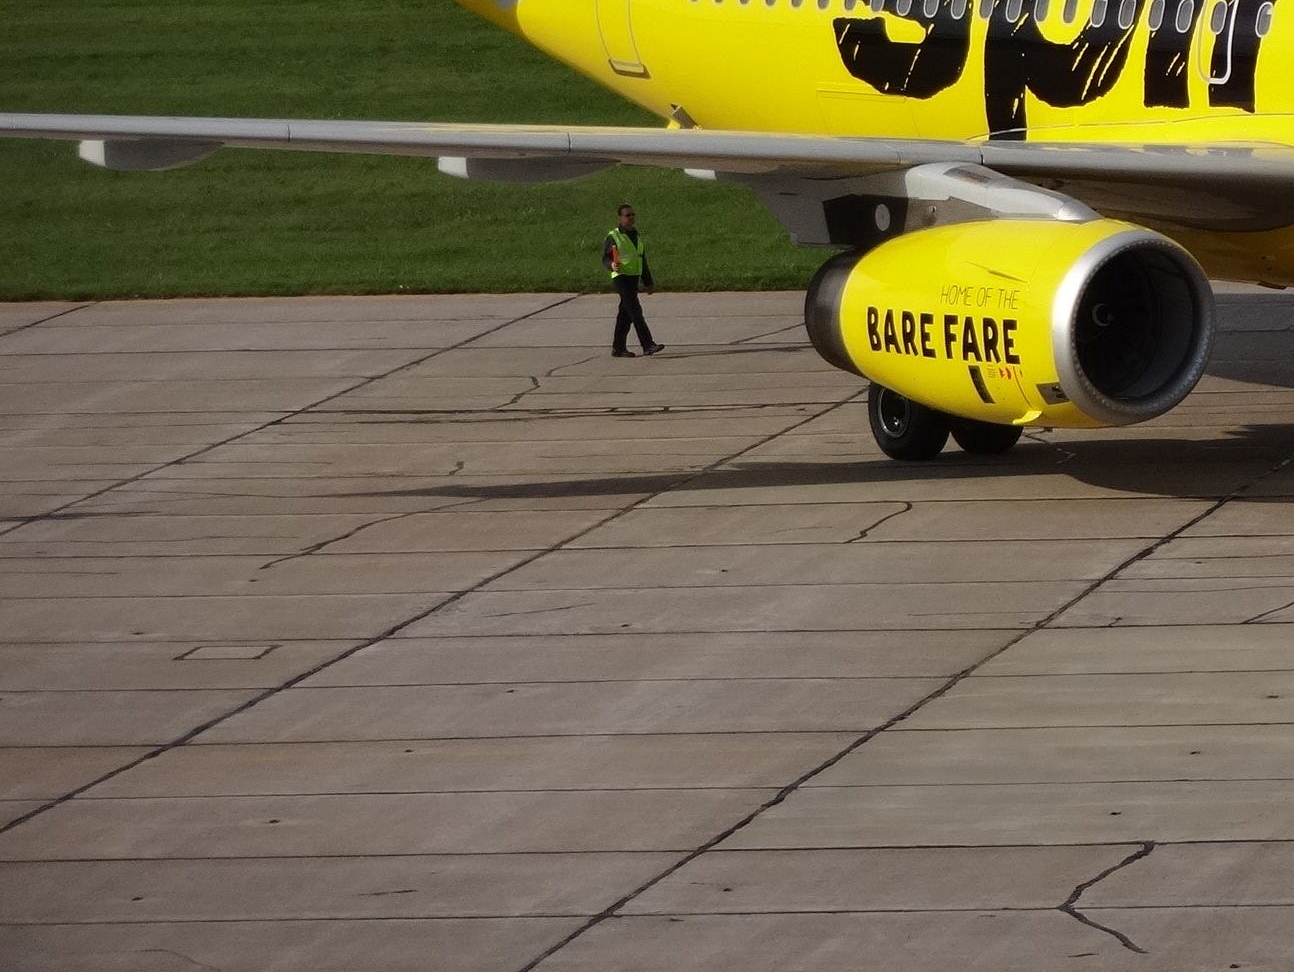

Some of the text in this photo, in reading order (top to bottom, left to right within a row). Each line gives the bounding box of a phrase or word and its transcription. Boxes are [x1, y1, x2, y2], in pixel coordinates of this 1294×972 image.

[941, 285, 1020, 309] HOME OF THE
[867, 307, 1021, 364] BARE FARE
